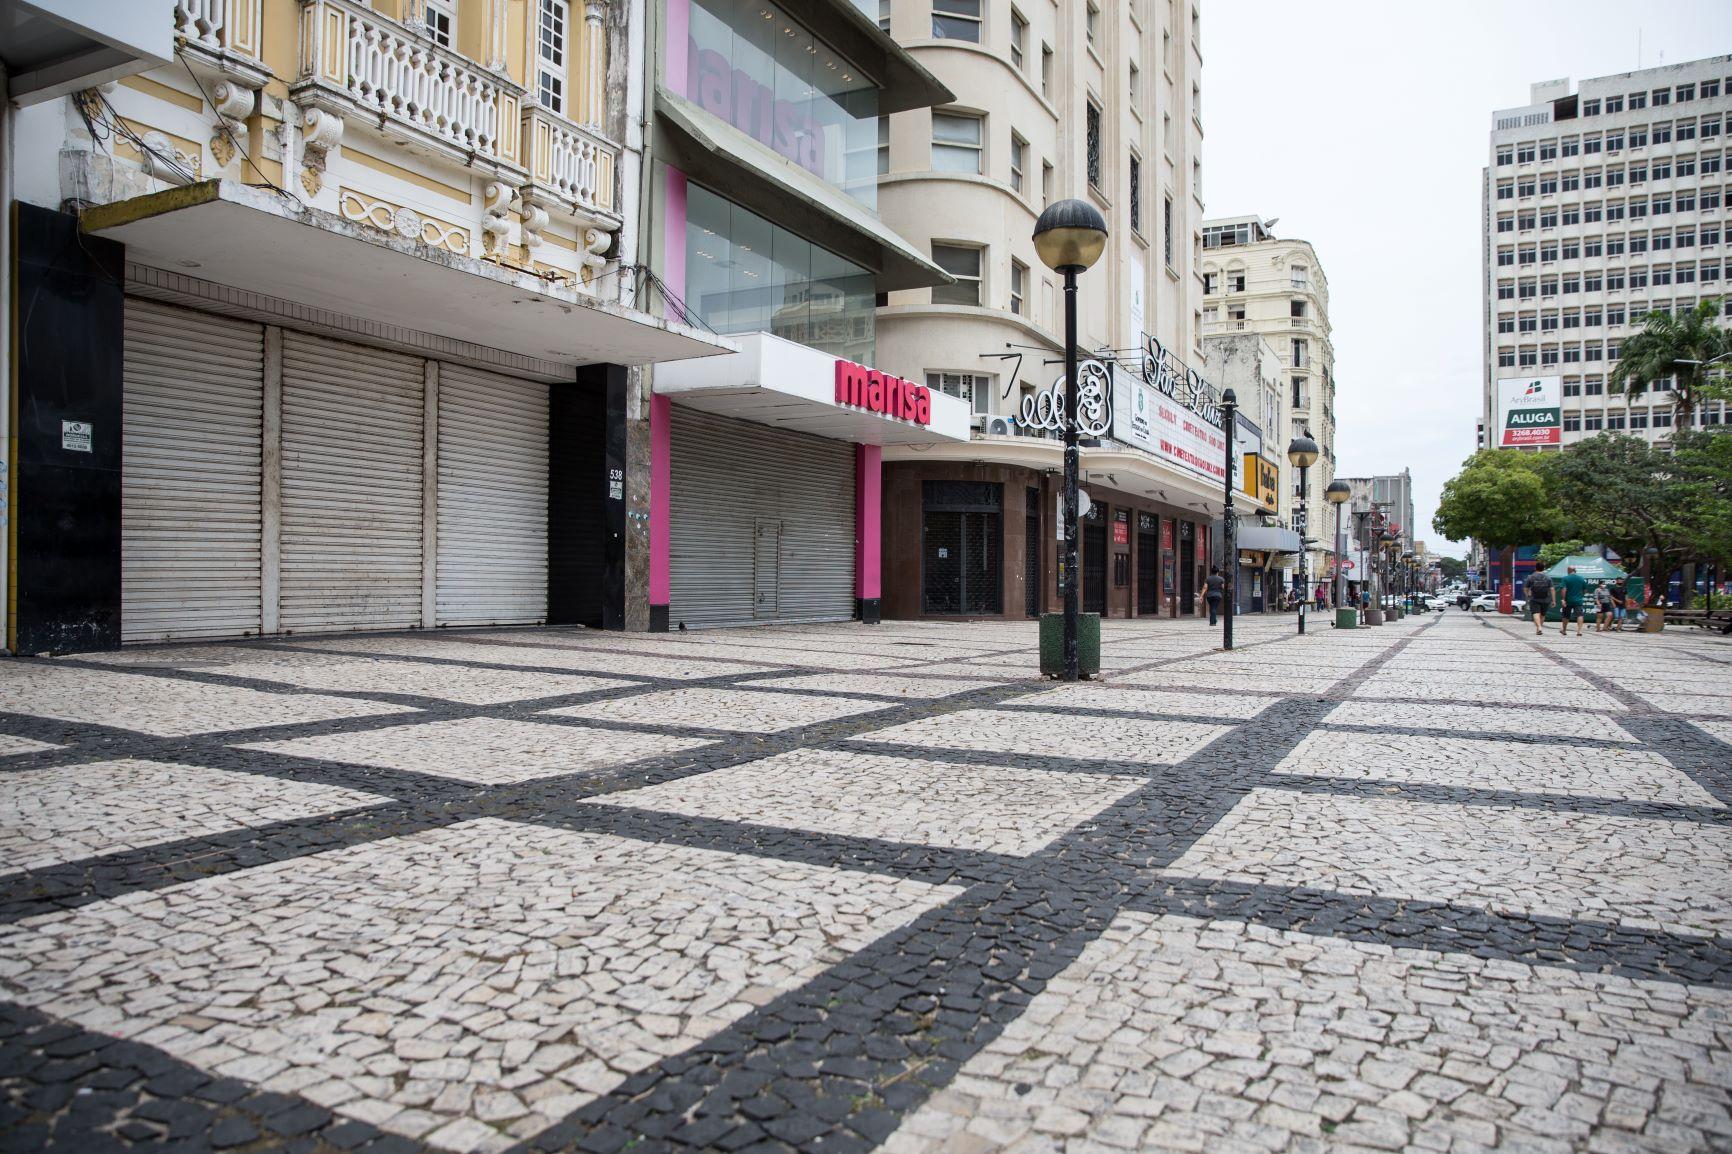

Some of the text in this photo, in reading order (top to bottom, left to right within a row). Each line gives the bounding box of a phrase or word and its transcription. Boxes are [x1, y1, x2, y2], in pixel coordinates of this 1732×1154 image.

[1143, 336, 1176, 400] São
[835, 359, 931, 426] marisa
[1511, 412, 1555, 424] ALUGA
[1512, 428, 1550, 437] 3268.4030
[610, 469, 622, 480] 538
